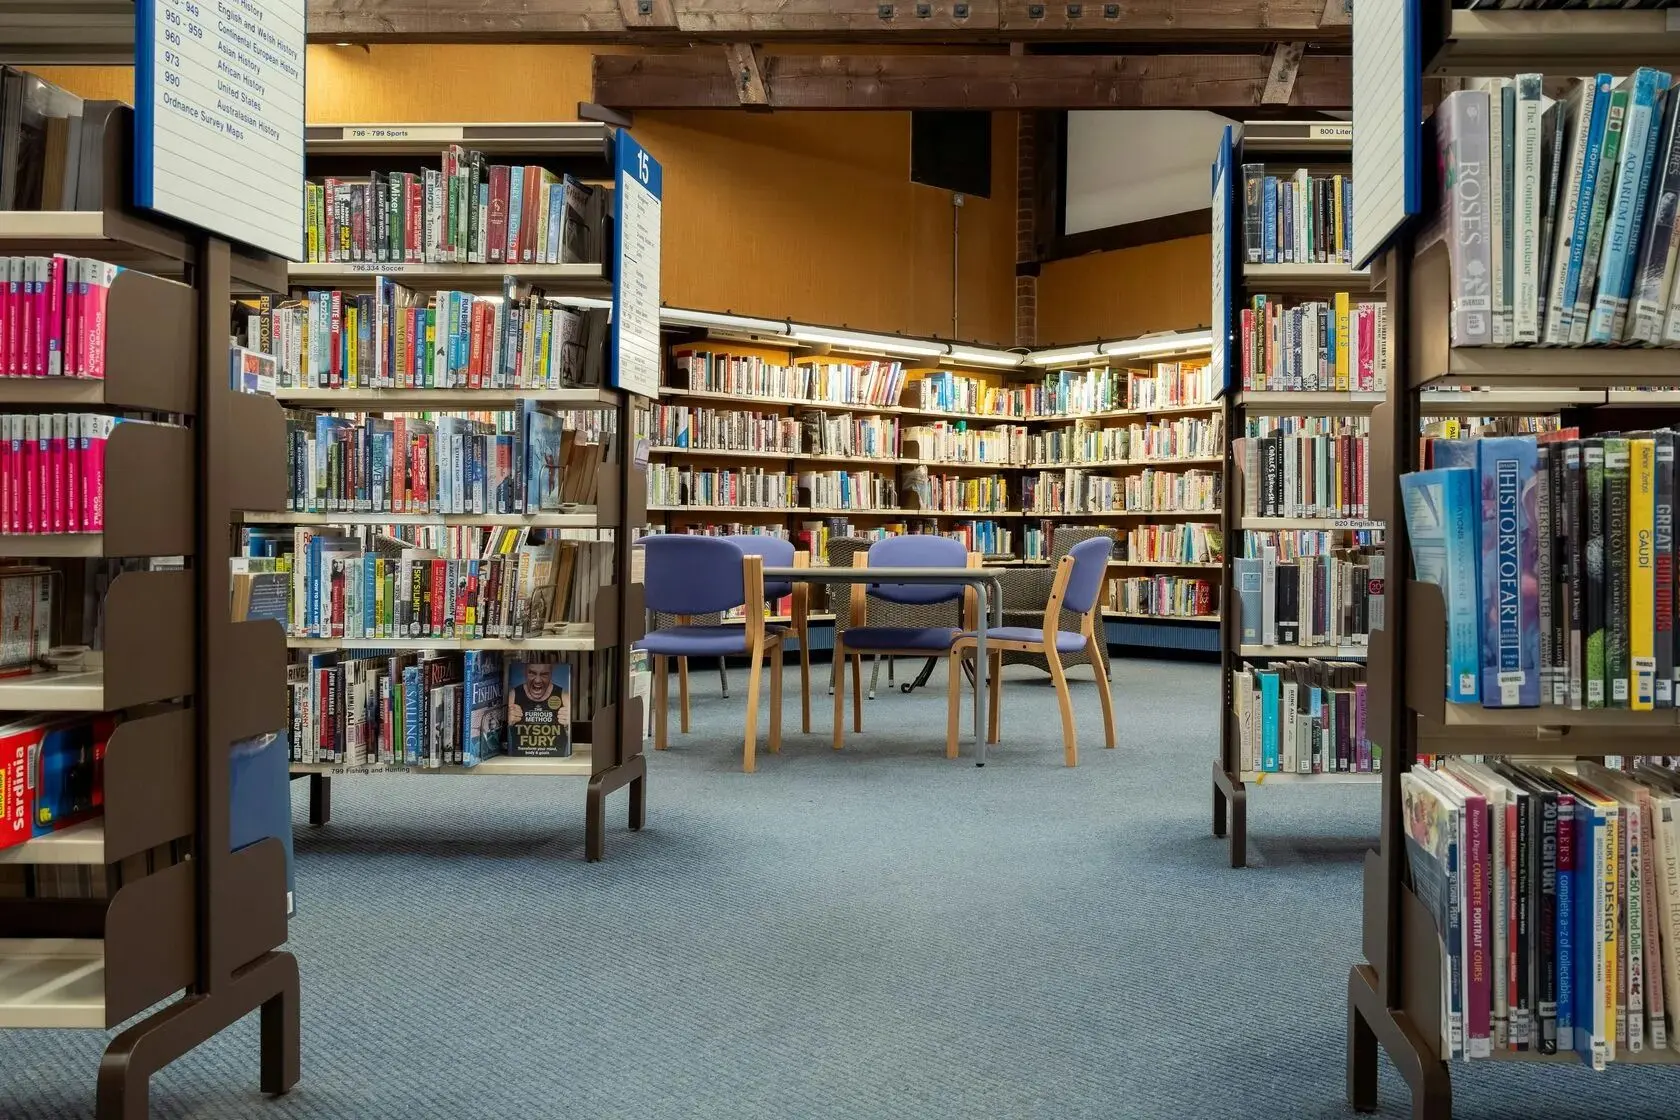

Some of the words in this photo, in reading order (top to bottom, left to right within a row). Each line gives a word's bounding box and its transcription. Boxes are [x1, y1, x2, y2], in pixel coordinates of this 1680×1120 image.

[165, 9, 180, 26] 950
[188, 22, 203, 39] 959
[218, 41, 236, 59] Asian
[238, 54, 260, 75] History
[185, 2, 199, 17] 949
[218, 21, 251, 48] Continental
[253, 43, 279, 67] European
[280, 58, 299, 79] History
[218, 2, 242, 23] English
[243, 18, 255, 33] and
[257, 23, 276, 45] Welsh
[277, 38, 298, 61] History
[165, 29, 180, 46] 960
[218, 60, 241, 80] African
[243, 75, 265, 95] History
[165, 51, 180, 67] 973
[218, 80, 239, 99] United
[241, 92, 262, 111] States
[164, 71, 180, 88] 990
[217, 99, 256, 127] Australasian
[259, 120, 280, 140] History
[164, 92, 199, 118] Ordnance
[200, 111, 224, 132] Survey
[226, 123, 244, 140] Maps
[1526, 103, 1537, 123] The
[1583, 84, 1595, 124] OWNING
[386, 130, 408, 138] Sports
[1526, 127, 1537, 172] Ultimate
[637, 149, 650, 184] 15
[1586, 144, 1599, 183] TROPICAL
[391, 183, 400, 213] Mixer
[511, 171, 519, 200] HENRY
[1459, 160, 1481, 246] ROSES
[1524, 174, 1536, 226] Container
[1616, 152, 1637, 221] AQUARIUM
[509, 213, 518, 248] BLOFELD
[1576, 186, 1593, 241] FRESHWATER
[426, 218, 434, 247] Tennis
[1611, 224, 1625, 253] FISH
[352, 264, 380, 272] 796.334
[381, 264, 405, 272] Soccer
[1523, 229, 1535, 277] Gardener
[1573, 243, 1585, 263] FISH
[260, 295, 269, 315] BEN
[331, 295, 340, 318] WHITE
[461, 298, 470, 314] RUN
[260, 317, 269, 354] STOKES
[331, 319, 340, 334] HOT
[460, 314, 469, 341] BRITAIN
[88, 329, 96, 373] NORWICH
[441, 457, 448, 466] K2
[1350, 520, 1375, 528] English
[1499, 473, 1518, 557] HISTORY
[1540, 494, 1551, 549] WEEKEND
[1611, 479, 1622, 568] HIGHGROVE
[1656, 504, 1671, 552] GREAT
[413, 569, 421, 589] SKY'S
[1500, 561, 1517, 588] OF
[1540, 553, 1552, 618] CARPENTER
[413, 592, 421, 613] LIMIT
[1500, 591, 1517, 627] ART
[1656, 555, 1672, 632] BUILDINGS
[472, 681, 503, 705] FISHING
[294, 717, 302, 730] Guy
[347, 711, 355, 726] ALI
[405, 690, 418, 747] SAILING
[515, 724, 561, 736] TYSON
[519, 735, 557, 747] FURY
[12, 745, 25, 832] Sardinia
[346, 767, 370, 775] Fishing
[385, 766, 410, 774] Hunting
[1542, 835, 1557, 895] CENTURY
[1605, 864, 1614, 877] OF
[1665, 856, 1680, 898] DOLLS'
[1472, 862, 1482, 906] COMPLETE
[1558, 874, 1571, 917] complete
[1630, 879, 1641, 892] 50
[1450, 906, 1459, 929] PEOPLE
[1473, 907, 1483, 947] PORTRAIT
[1559, 919, 1570, 936] a-z
[1604, 881, 1616, 942] DESIGN
[1630, 894, 1641, 930] Knitted
[1559, 938, 1571, 948] of
[1630, 933, 1641, 955] Dolls
[1473, 950, 1483, 982] COURSE
[1559, 950, 1571, 1004] collectables
